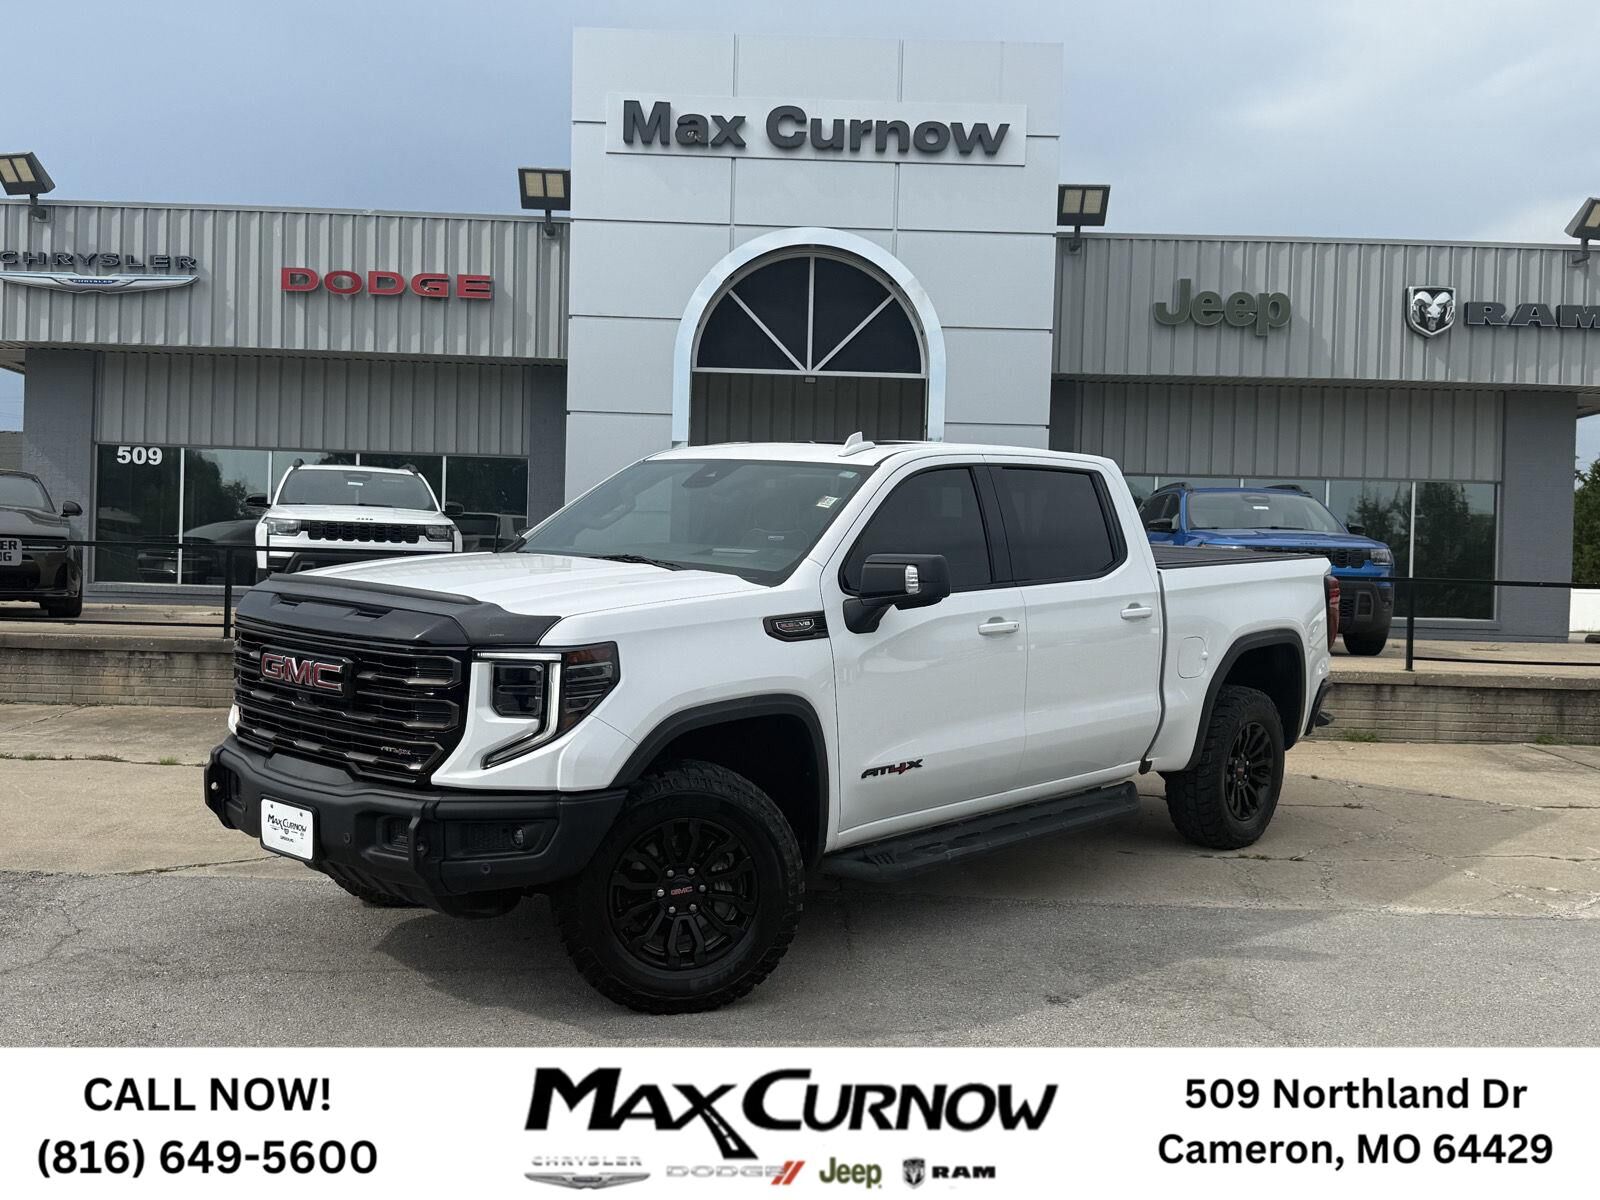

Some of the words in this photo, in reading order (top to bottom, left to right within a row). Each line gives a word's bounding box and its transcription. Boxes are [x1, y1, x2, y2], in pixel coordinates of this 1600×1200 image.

[622, 100, 747, 148] Max
[766, 104, 1010, 155] Curnow
[0, 250, 198, 270] CHRYSLER
[281, 267, 492, 299] DODGE
[1153, 278, 1291, 337] Jeep
[1464, 301, 1600, 329] RAM
[116, 445, 163, 465] 509
[261, 652, 344, 692] GMC
[861, 758, 923, 779] AT4X
[670, 886, 693, 896] GMC
